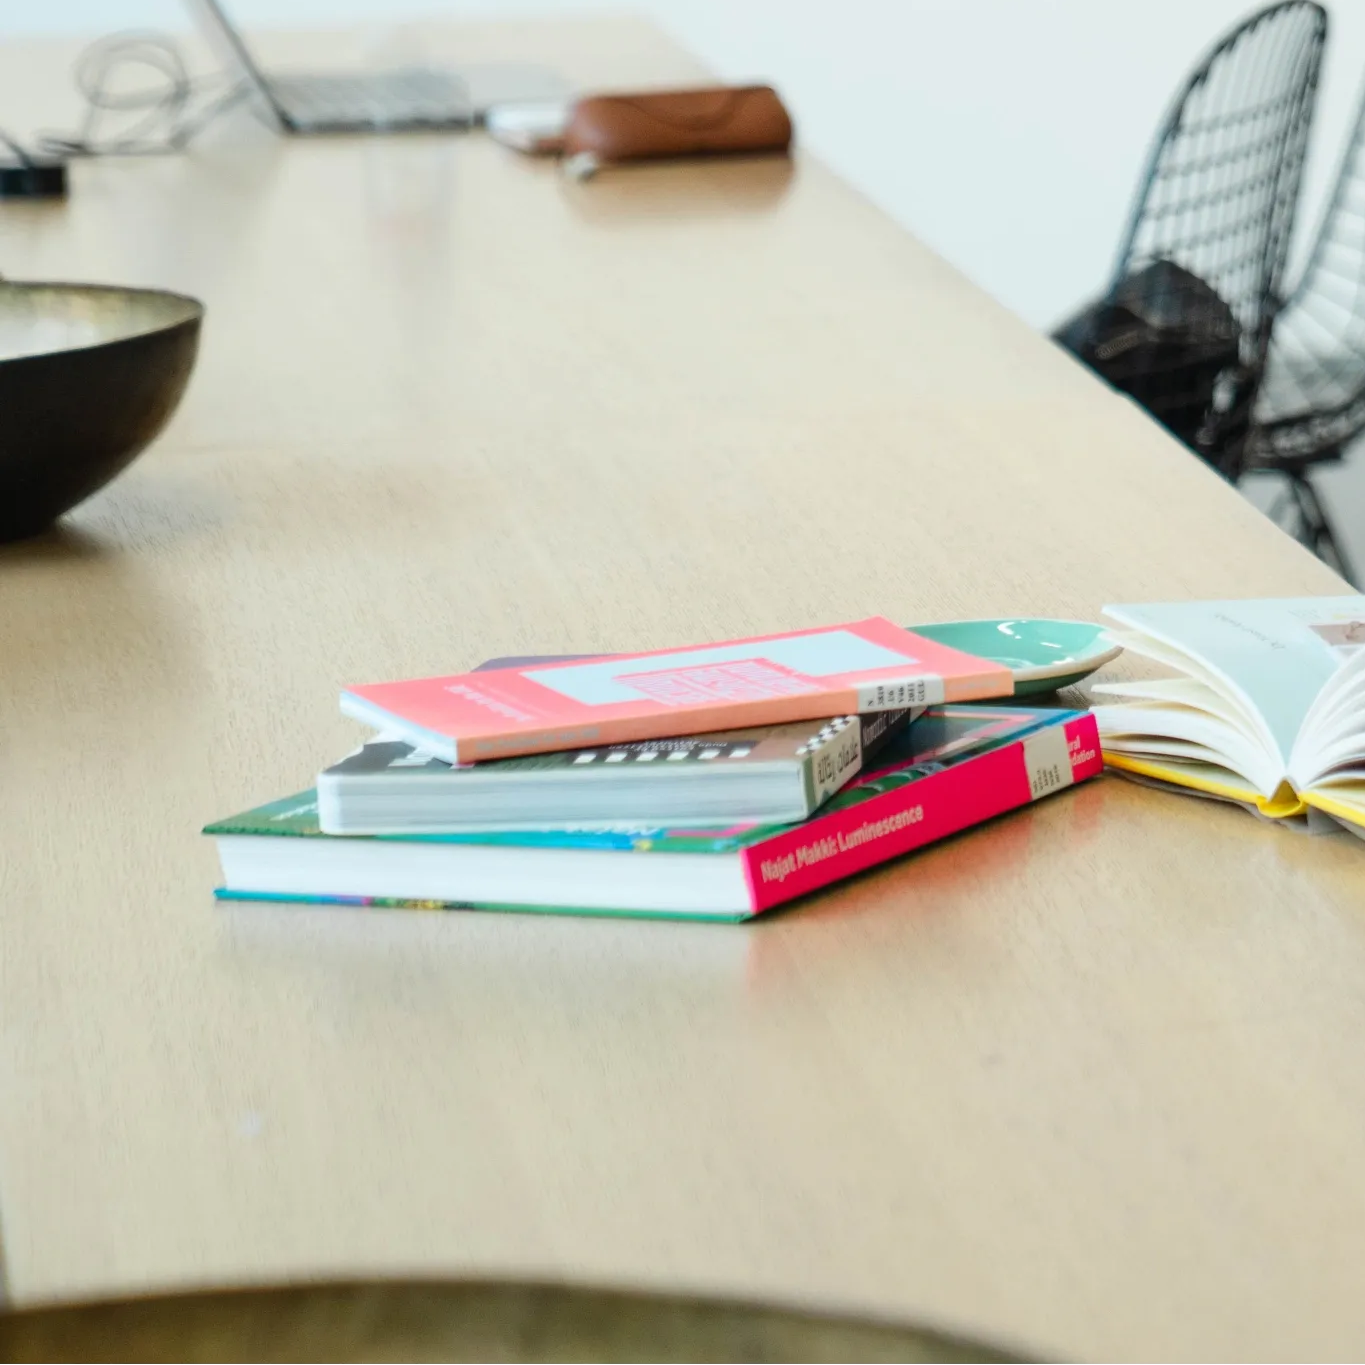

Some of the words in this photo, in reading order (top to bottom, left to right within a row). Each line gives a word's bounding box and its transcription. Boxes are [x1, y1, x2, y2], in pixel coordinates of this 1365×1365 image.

[760, 851, 796, 883] Najat
[796, 835, 838, 868] Makki:
[837, 804, 924, 853] Luminescence
